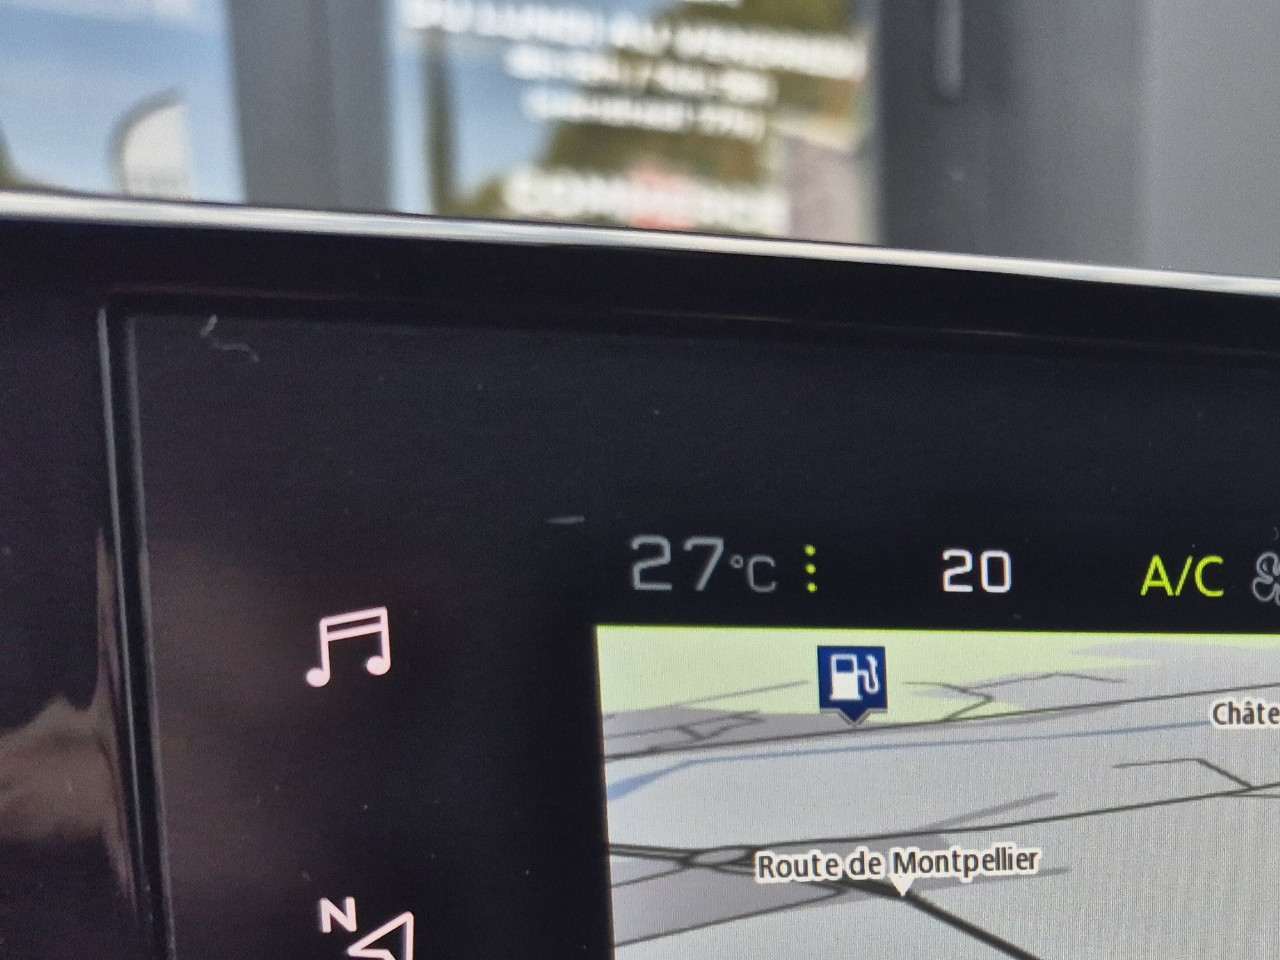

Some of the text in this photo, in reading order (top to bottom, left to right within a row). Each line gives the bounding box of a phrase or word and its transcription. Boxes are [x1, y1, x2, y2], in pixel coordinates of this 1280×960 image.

[941, 549, 1013, 593] 20
[1139, 555, 1225, 598] A/C
[758, 847, 1038, 879] Route de Montpellier
[320, 896, 357, 933] N
